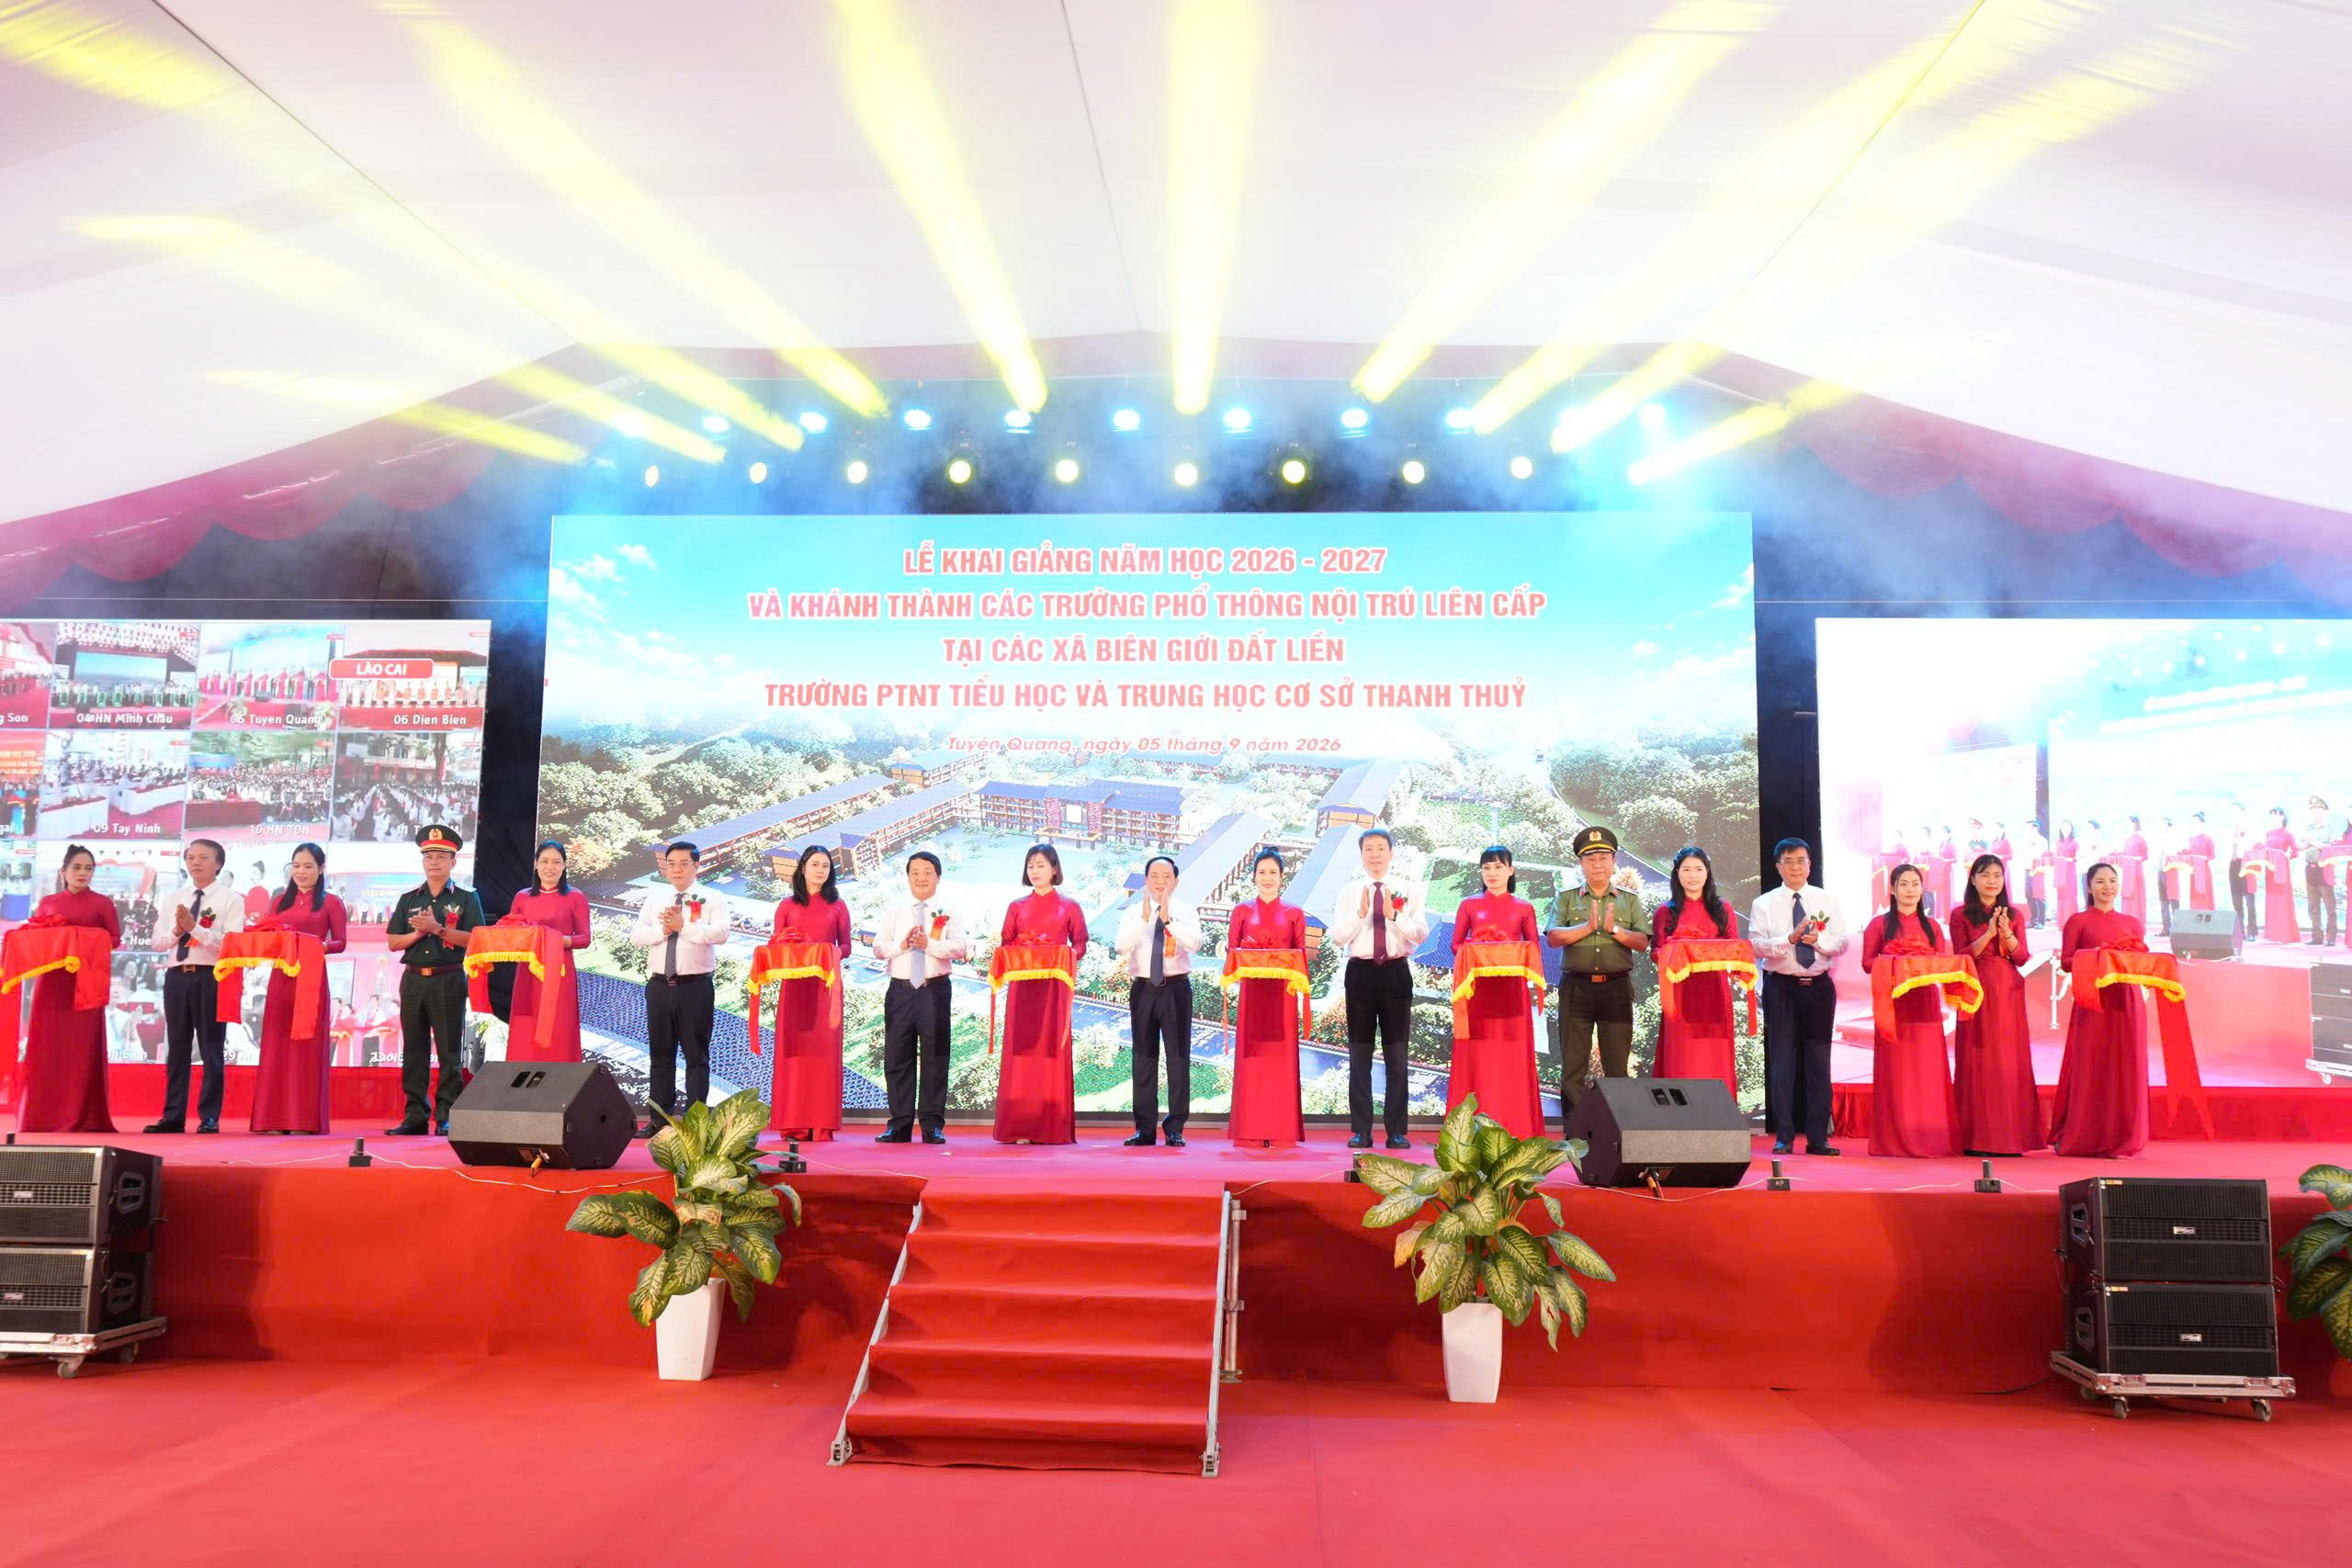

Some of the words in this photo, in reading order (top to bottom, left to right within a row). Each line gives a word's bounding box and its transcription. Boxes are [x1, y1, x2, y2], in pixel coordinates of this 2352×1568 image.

[904, 540, 933, 573] LỄ
[942, 550, 1002, 573] KHAI
[1012, 542, 1091, 573] GIẢNG
[1100, 545, 1160, 572] NĂM
[1170, 549, 1222, 578] HỌC
[1231, 548, 1295, 572] 2026
[1322, 548, 1385, 572] 2027
[749, 591, 781, 618] VÀ
[790, 591, 878, 618] KHÁNH
[888, 591, 971, 618] THÀNH
[981, 591, 1033, 618] CÁC
[1043, 589, 1145, 617] TRƯỜNG
[1155, 584, 1208, 617] PHỔ
[1216, 589, 1302, 617] THÔNG
[1312, 588, 1356, 623] NỘI
[1365, 589, 1415, 616] TRÚ
[1425, 589, 1483, 616] LIÊN
[1493, 584, 1545, 616] CẤP
[944, 638, 981, 667] TẠI
[991, 634, 1043, 662] CÁC
[1053, 634, 1087, 662] XÃ
[1096, 634, 1157, 662] BIÊN
[1167, 634, 1218, 662] GIỚI
[1227, 630, 1278, 662] ĐẤT
[1286, 630, 1344, 662] LIỀN
[356, 661, 382, 676] LÀO
[384, 663, 407, 676] CAI
[765, 680, 868, 706] TRƯỜNG
[877, 684, 942, 706] PTNT
[950, 674, 1005, 706] TIỂU
[1014, 683, 1067, 713] HỌC
[1076, 679, 1108, 706] VÀ
[1116, 683, 1204, 707] TRUNG
[1214, 683, 1265, 712] HỌC
[1275, 682, 1311, 707] CƠ
[1319, 676, 1354, 707] SỞ
[1363, 684, 1451, 707] THANH
[1460, 676, 1527, 707] THUỶ
[249, 714, 282, 727] Tuyen
[286, 714, 321, 727] Quang
[393, 714, 409, 725] 06
[413, 714, 438, 725] Dien
[442, 714, 467, 725] Bien
[948, 737, 1000, 752] Tuyên
[1083, 736, 1132, 755] ngày
[1137, 738, 1161, 750] 05
[1168, 738, 1222, 755] tháng
[1229, 738, 1240, 750] 9
[1246, 738, 1288, 750] năm
[1295, 738, 1341, 751] 2026
[94, 823, 109, 833] 09
[112, 823, 130, 836] Tay
[134, 822, 162, 833] Ninh
